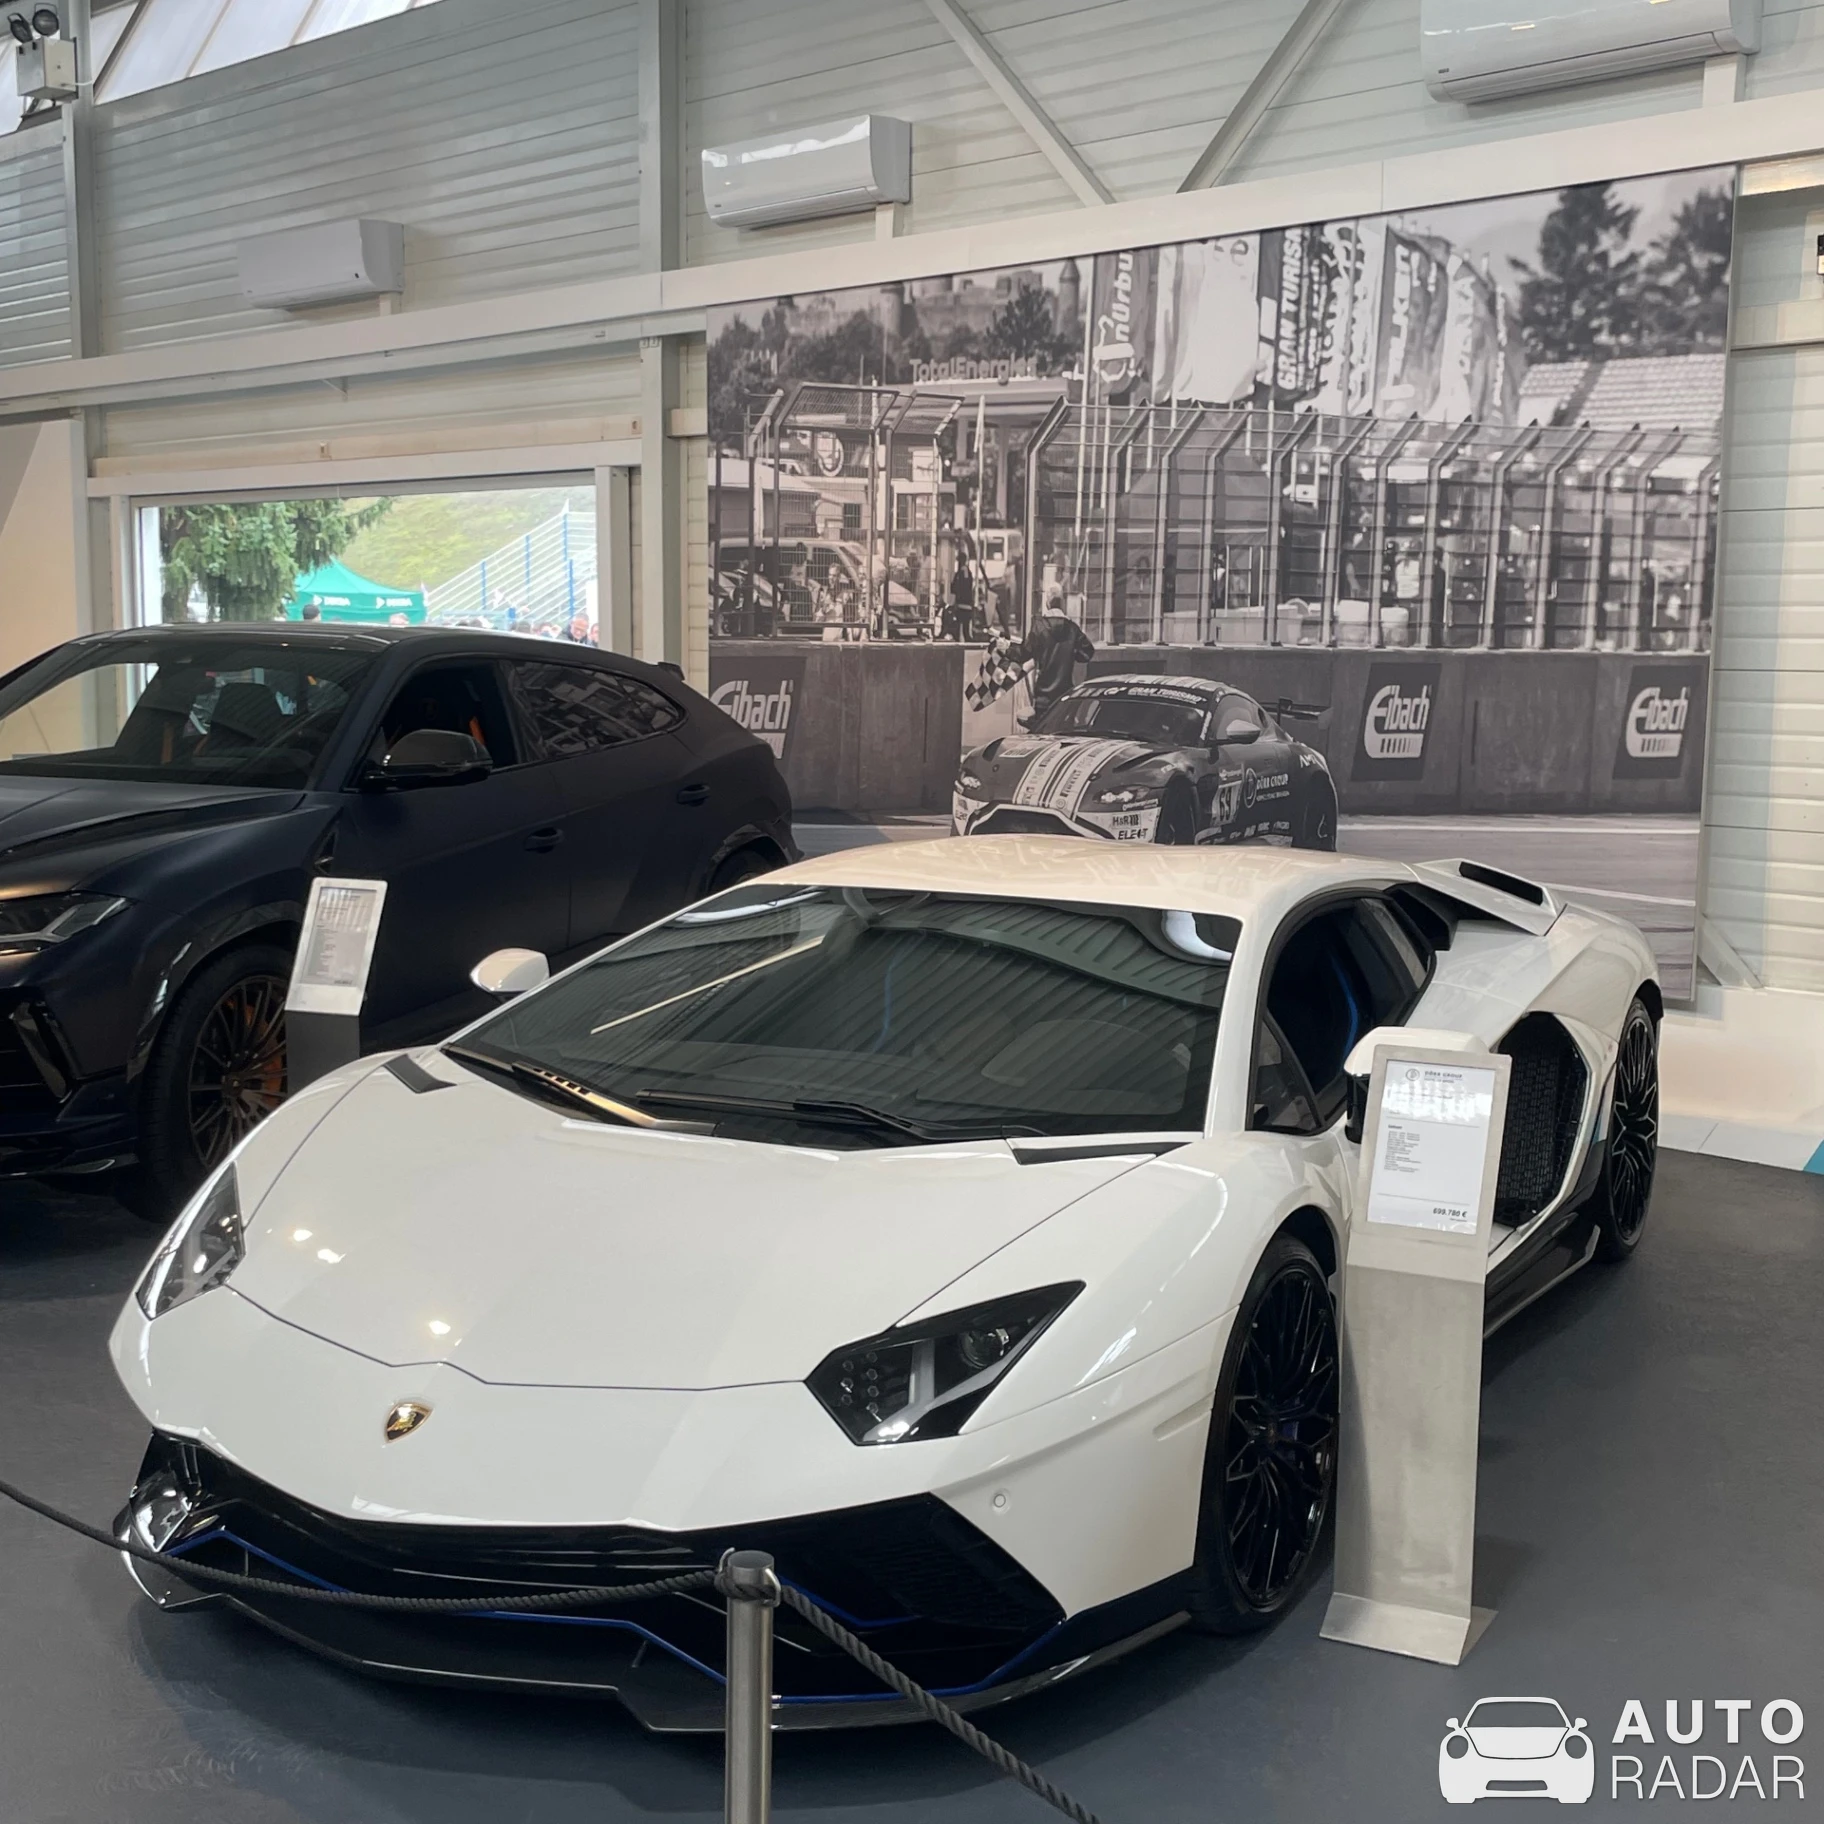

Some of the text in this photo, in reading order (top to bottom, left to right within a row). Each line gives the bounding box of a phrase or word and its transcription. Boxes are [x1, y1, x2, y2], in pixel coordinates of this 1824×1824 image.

[1277, 317, 1298, 391] GRAN
[710, 680, 793, 759] ibach
[1364, 685, 1432, 758] Eibach
[1626, 686, 1690, 757] Eibach
